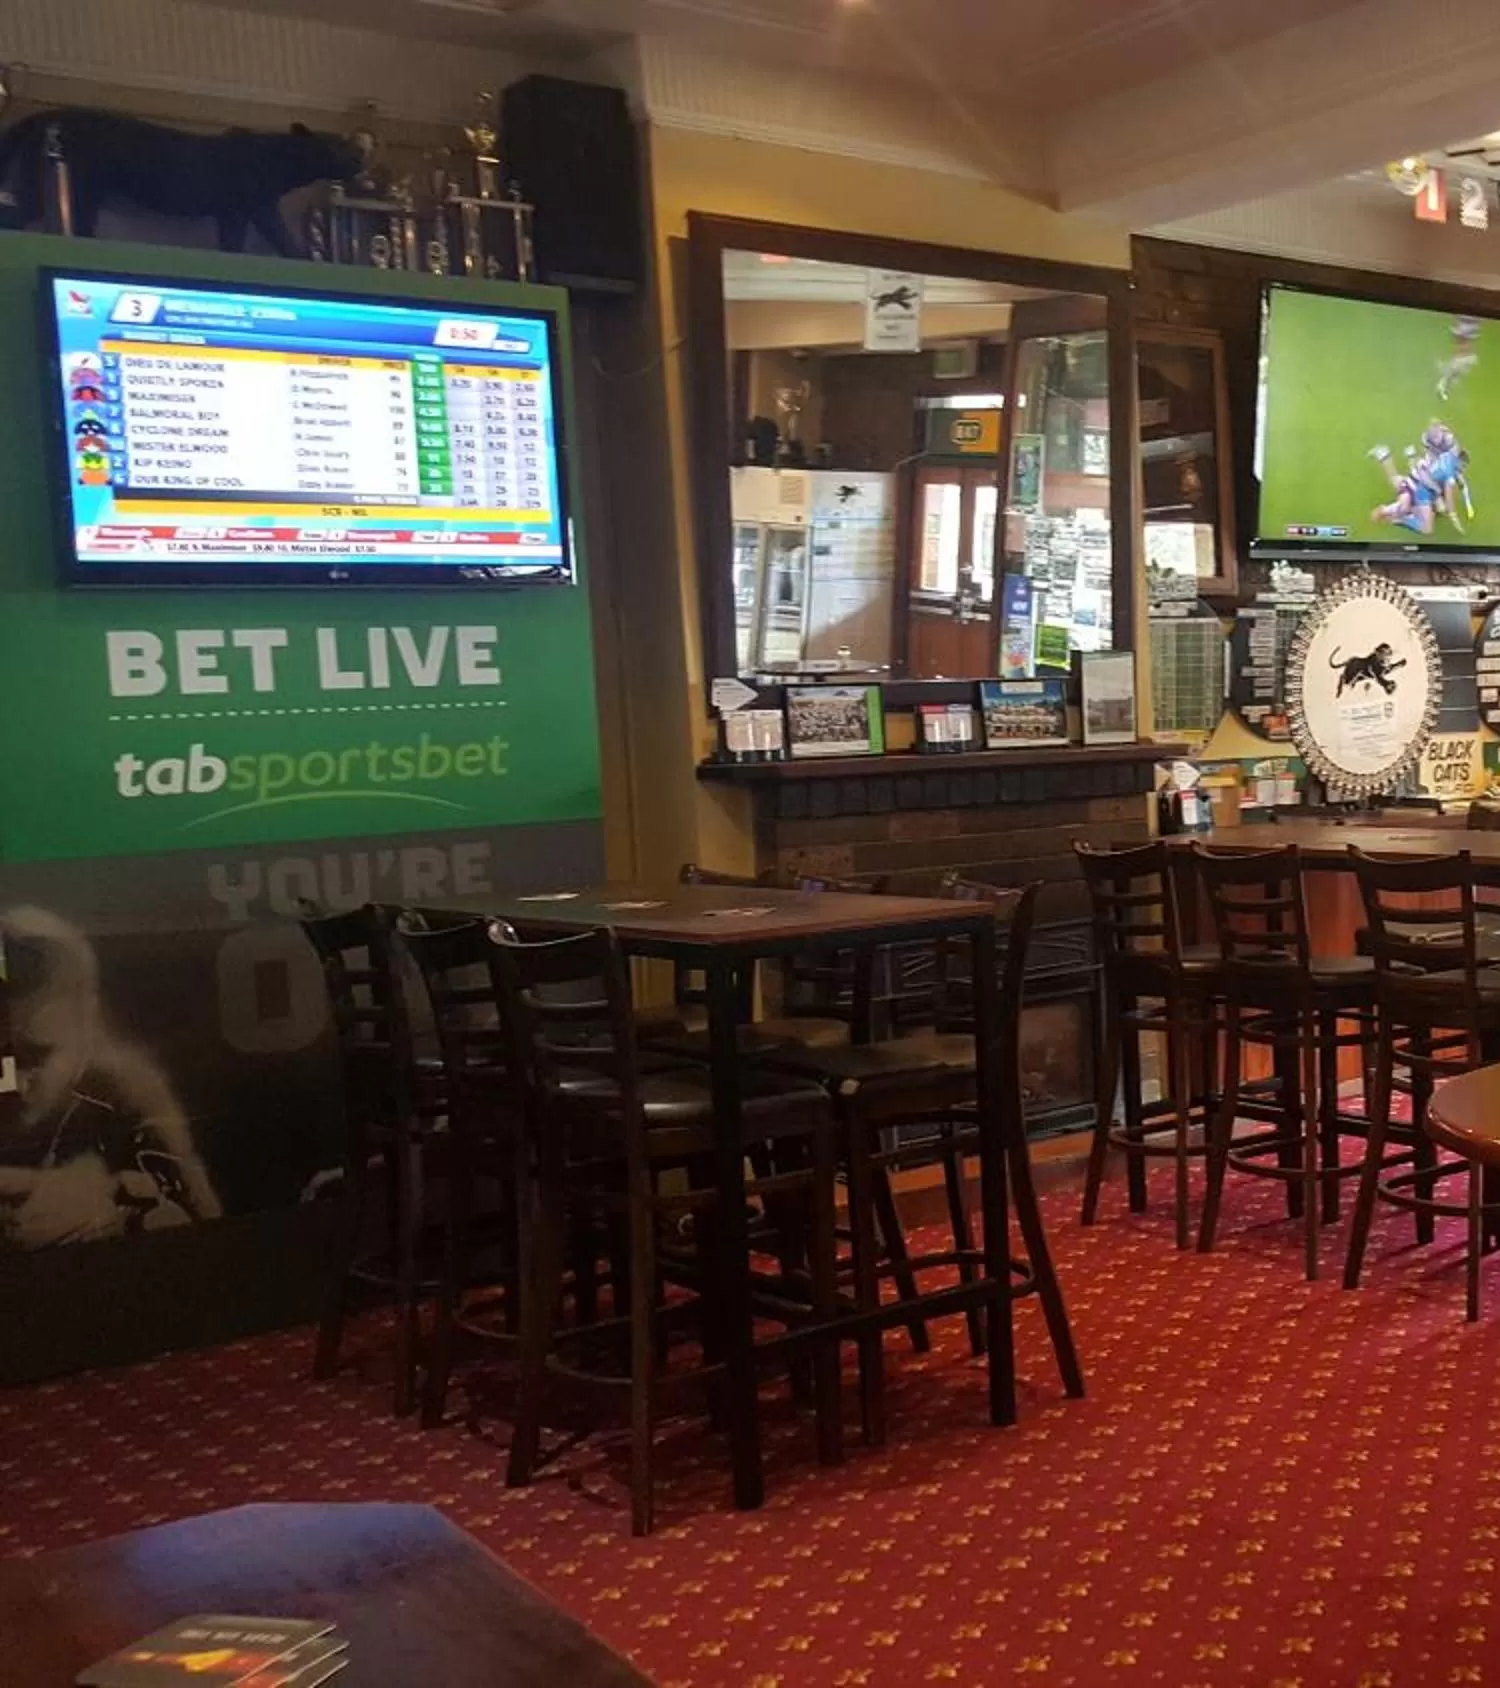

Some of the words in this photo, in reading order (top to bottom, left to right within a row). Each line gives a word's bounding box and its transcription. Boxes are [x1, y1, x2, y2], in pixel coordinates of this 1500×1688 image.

[1422, 169, 1440, 212] 1
[1461, 177, 1486, 216] 2
[129, 299, 143, 317] 3
[106, 626, 288, 698] BET
[316, 624, 502, 692] LIVE
[114, 733, 509, 803] tabsportsbet
[1427, 739, 1475, 761] BLACK
[1433, 761, 1471, 783] CATS
[207, 840, 495, 922] YOU'RE
